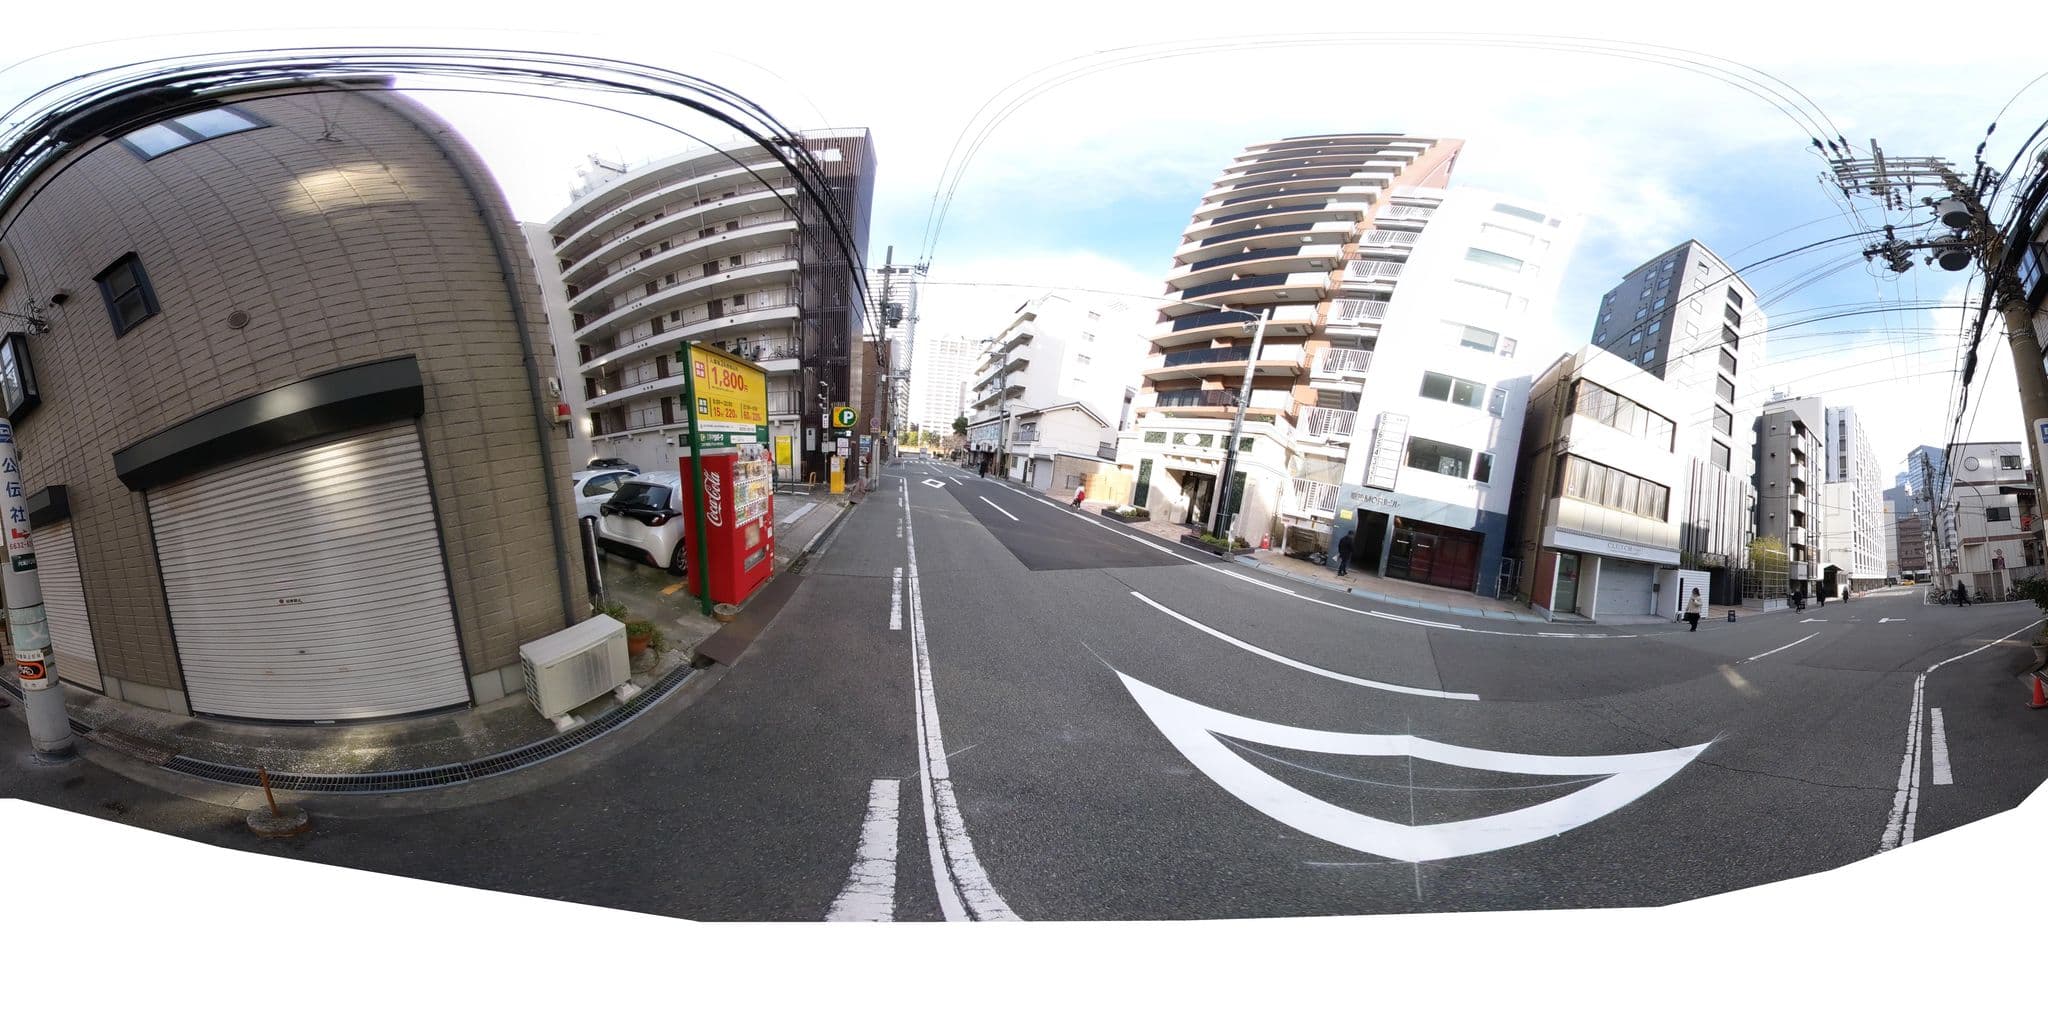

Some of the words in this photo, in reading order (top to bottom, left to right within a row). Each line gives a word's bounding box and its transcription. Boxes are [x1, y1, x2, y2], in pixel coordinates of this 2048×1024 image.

[843, 410, 854, 424] P
[2, 457, 27, 524] 公伝社
